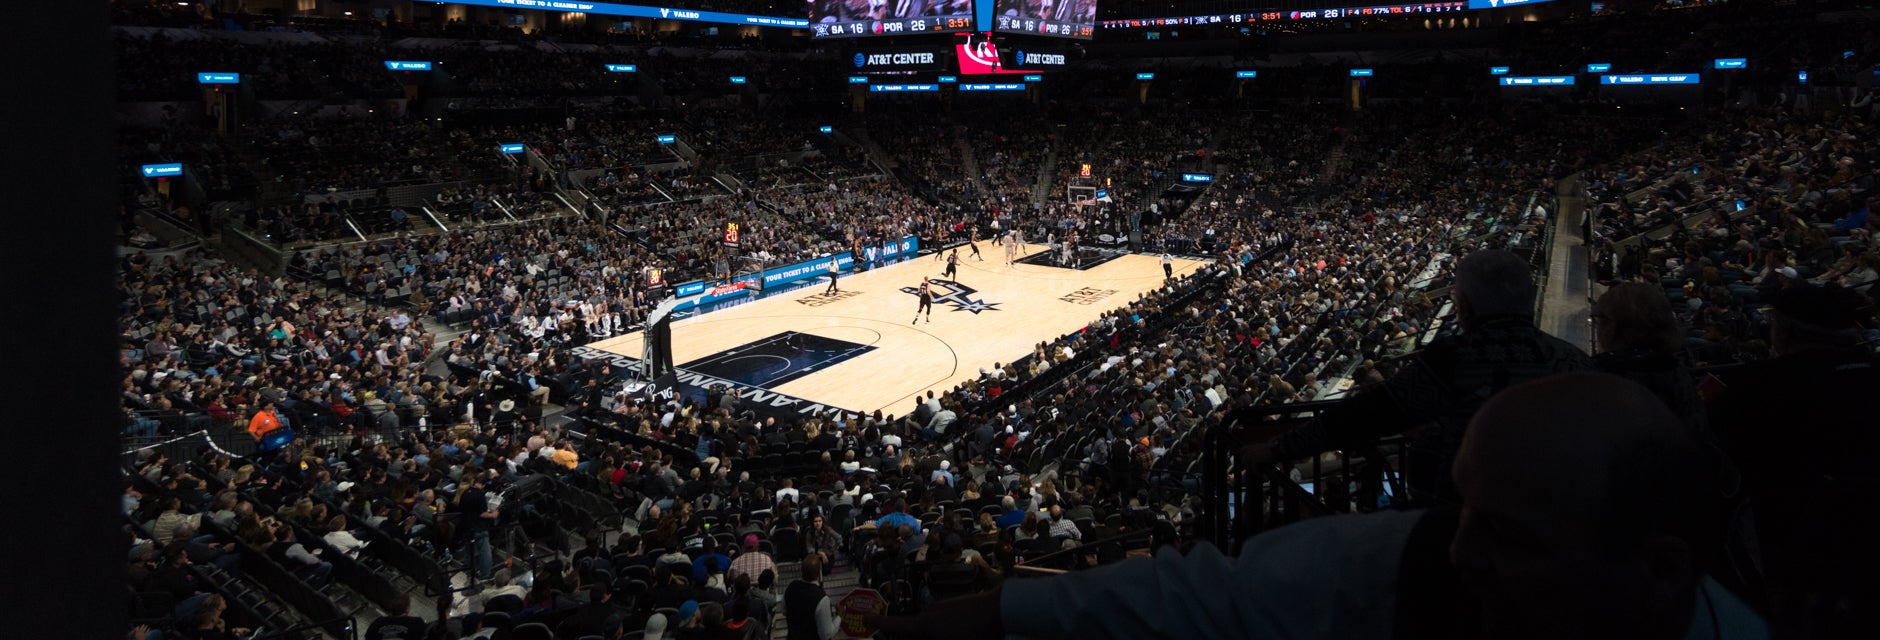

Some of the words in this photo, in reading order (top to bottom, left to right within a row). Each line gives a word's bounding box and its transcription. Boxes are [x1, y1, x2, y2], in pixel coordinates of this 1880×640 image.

[832, 26, 844, 34] SA
[850, 23, 863, 33] 16
[884, 23, 903, 32] POR
[911, 20, 925, 31] 26
[949, 18, 969, 27] 3:51
[1012, 20, 1020, 29] SA
[1025, 21, 1033, 30] 16
[1046, 25, 1058, 33] POR
[1062, 25, 1070, 34] 26
[867, 54, 892, 65] AT&T
[893, 53, 934, 64] CENTER
[1026, 53, 1042, 64] AT&T
[1042, 54, 1065, 65] CENTER
[726, 230, 737, 241] 20
[766, 274, 782, 282] YOUR
[783, 269, 801, 278] TICKET
